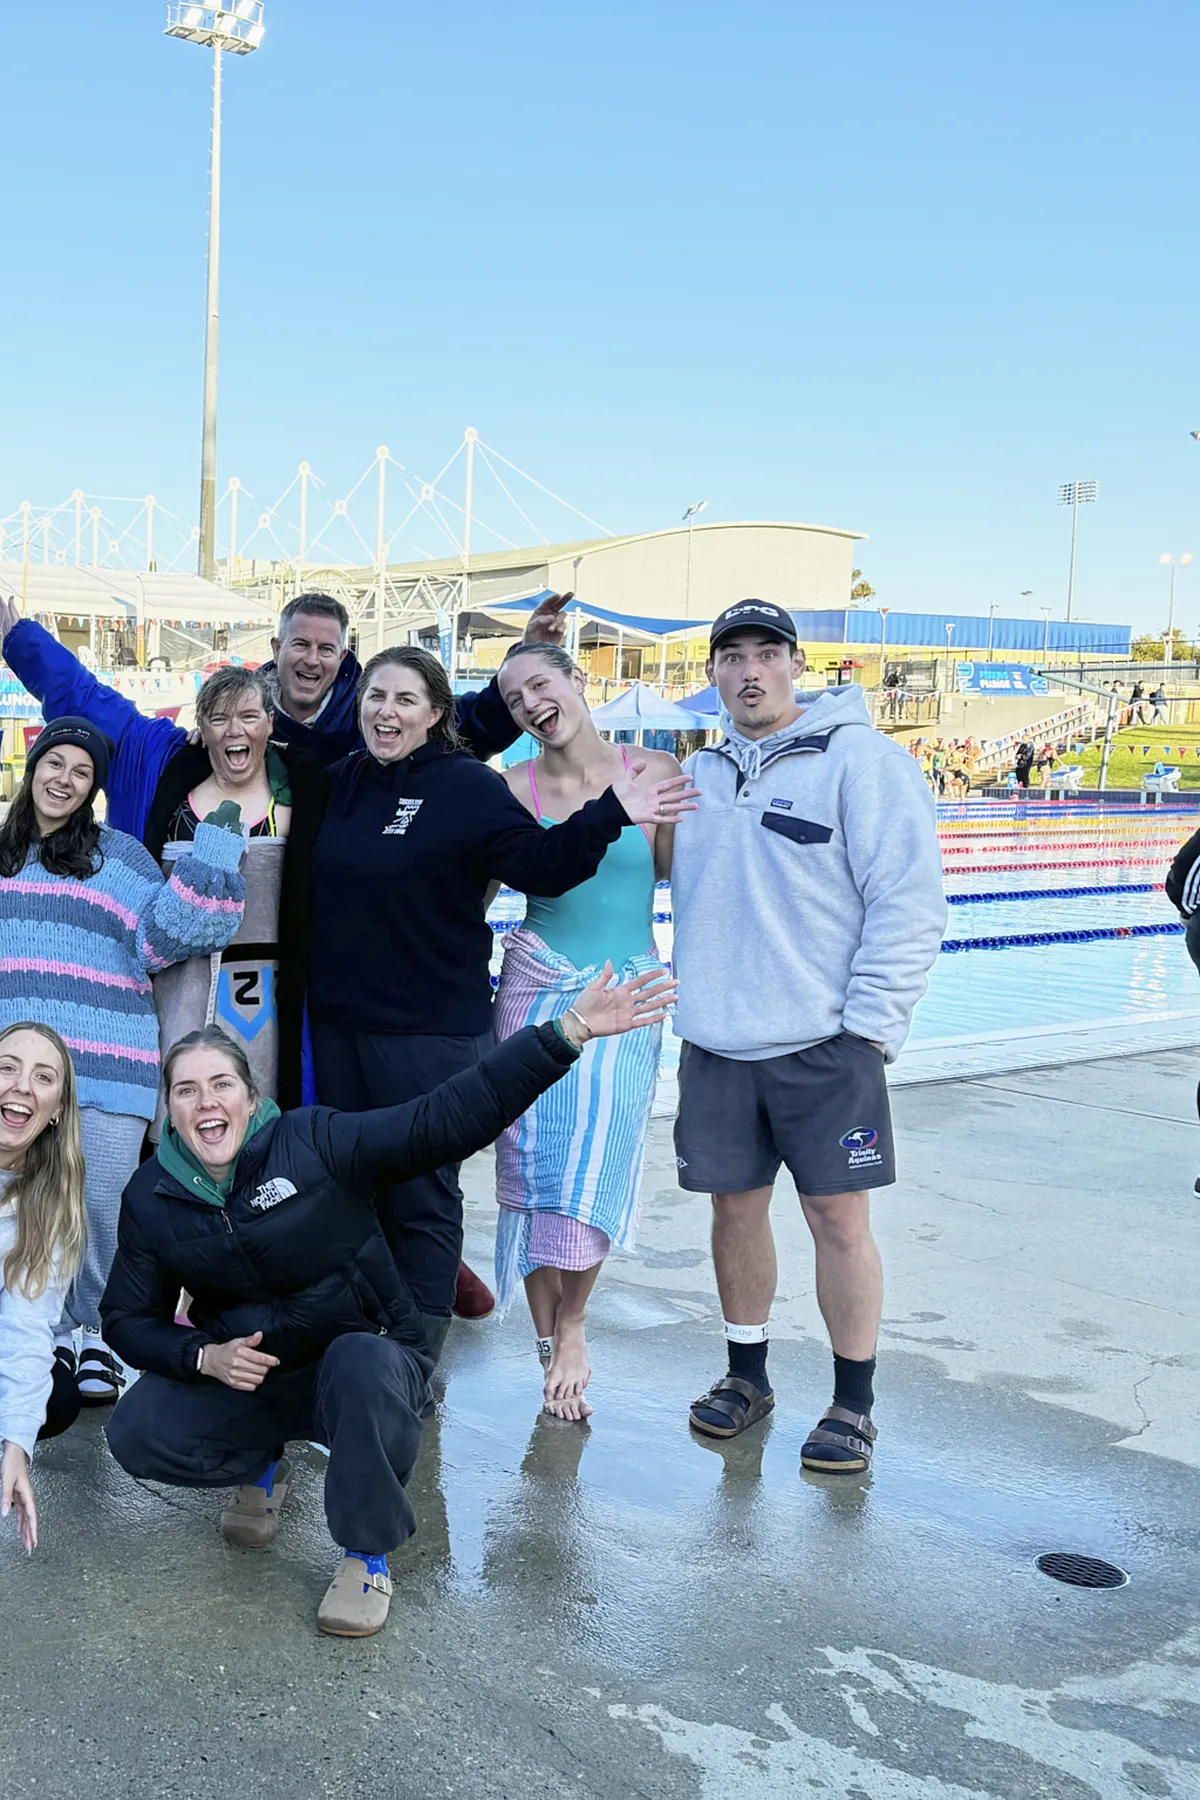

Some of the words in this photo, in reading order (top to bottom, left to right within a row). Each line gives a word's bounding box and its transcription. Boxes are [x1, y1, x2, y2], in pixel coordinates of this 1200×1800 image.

[848, 1153, 882, 1165] Aquinas
[849, 1148, 876, 1158] Trinity
[255, 1180, 275, 1194] THE
[250, 1187, 278, 1208] NORTH
[261, 1194, 282, 1211] FACE
